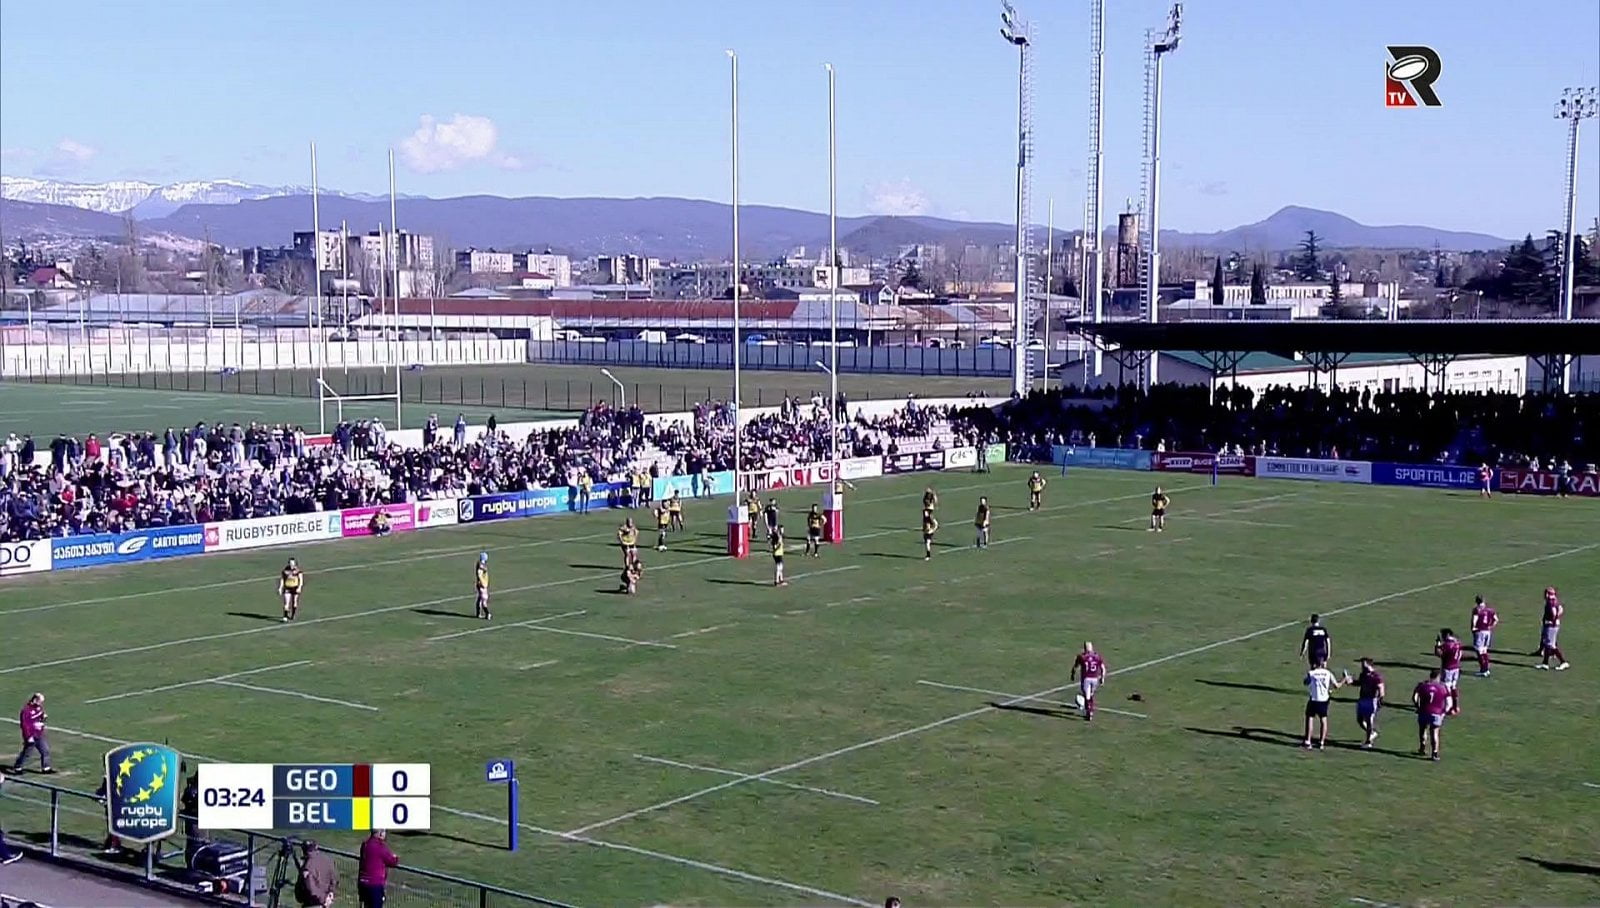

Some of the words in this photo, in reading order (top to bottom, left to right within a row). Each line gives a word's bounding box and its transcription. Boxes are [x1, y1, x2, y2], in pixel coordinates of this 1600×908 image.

[482, 500, 516, 514] rugby
[226, 519, 323, 542] RUGBYSTORE.GE
[178, 533, 203, 546] GROUP
[1084, 661, 1097, 672] 15
